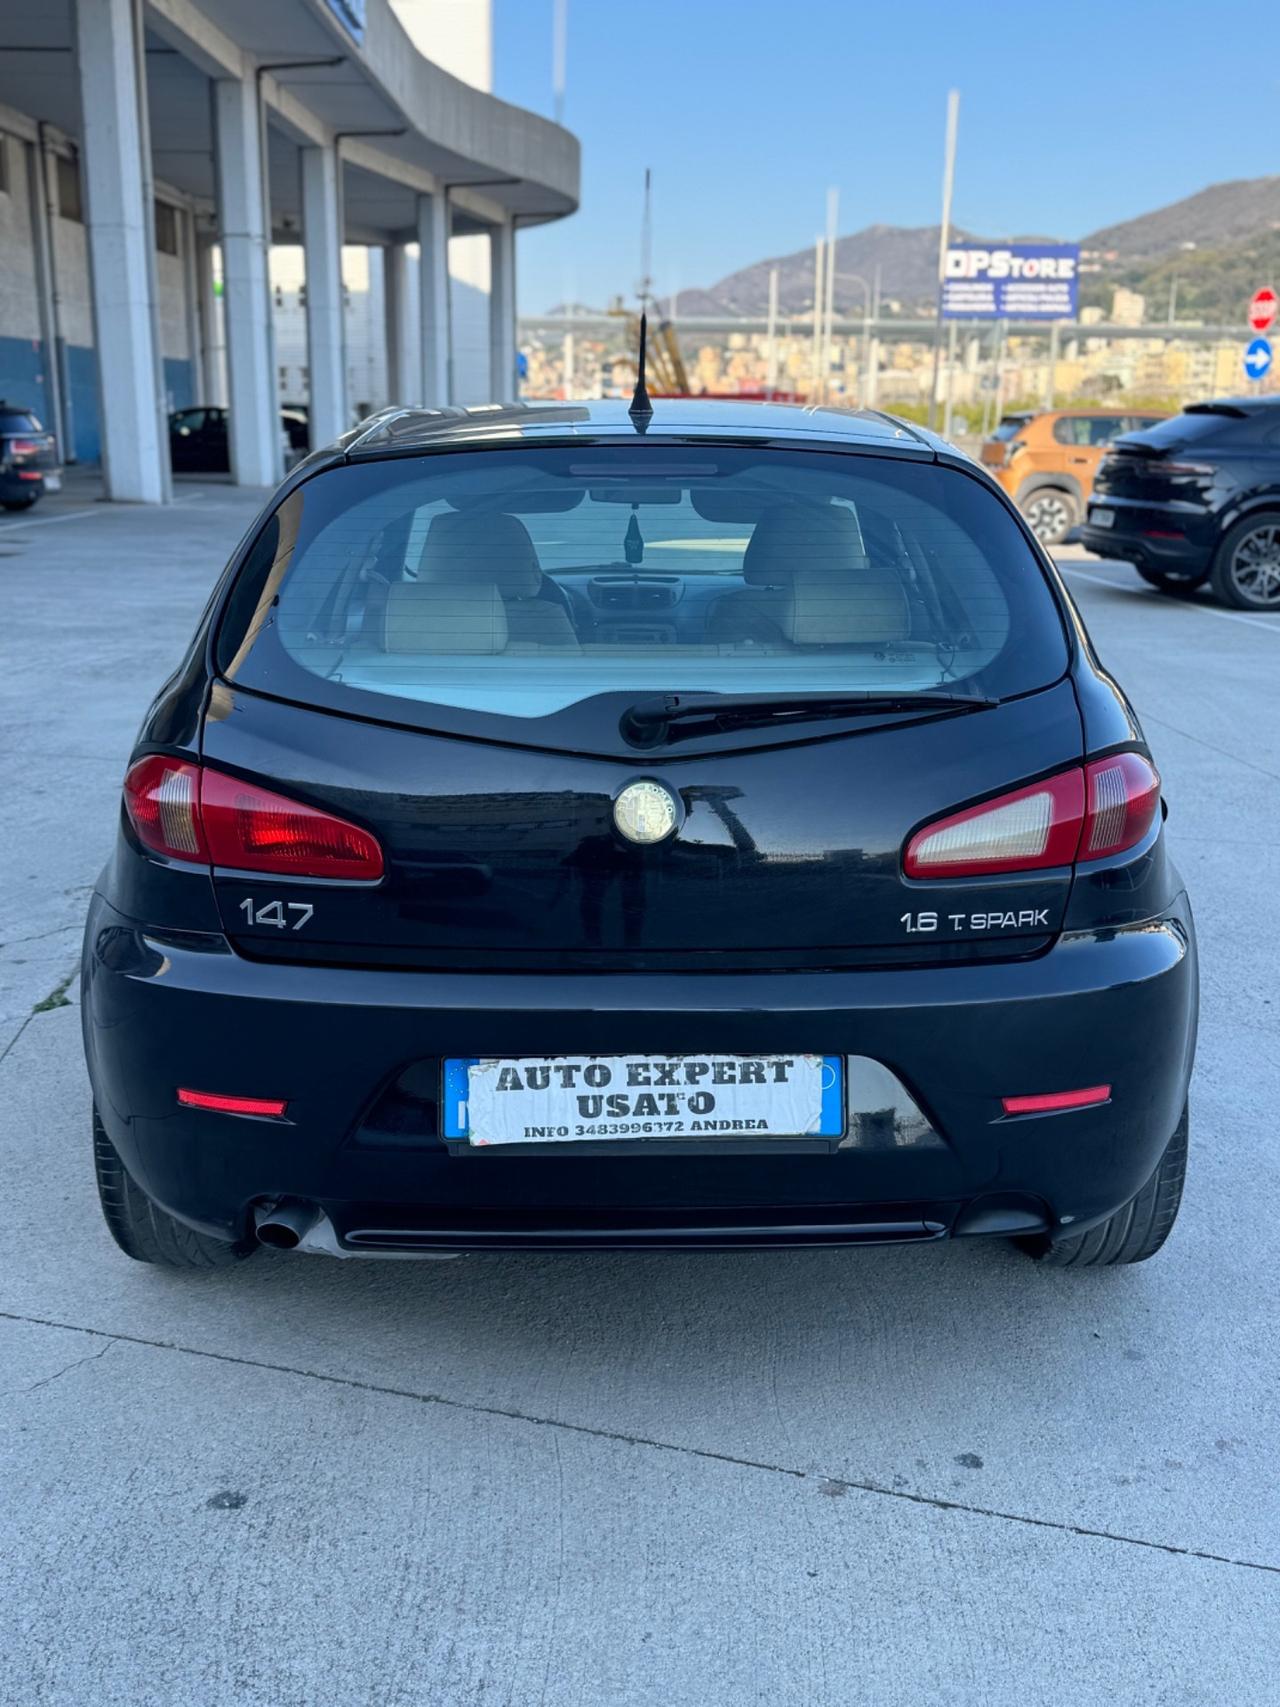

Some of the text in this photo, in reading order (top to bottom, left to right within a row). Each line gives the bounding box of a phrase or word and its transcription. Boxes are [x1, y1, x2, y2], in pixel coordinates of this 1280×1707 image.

[240, 898, 314, 930] 147
[900, 911, 938, 933] 1.6
[495, 1060, 794, 1091] AUTO EXPERT
[576, 1091, 716, 1118] USATO
[524, 1125, 569, 1138] INFO
[690, 1119, 769, 1131] ANDREA
